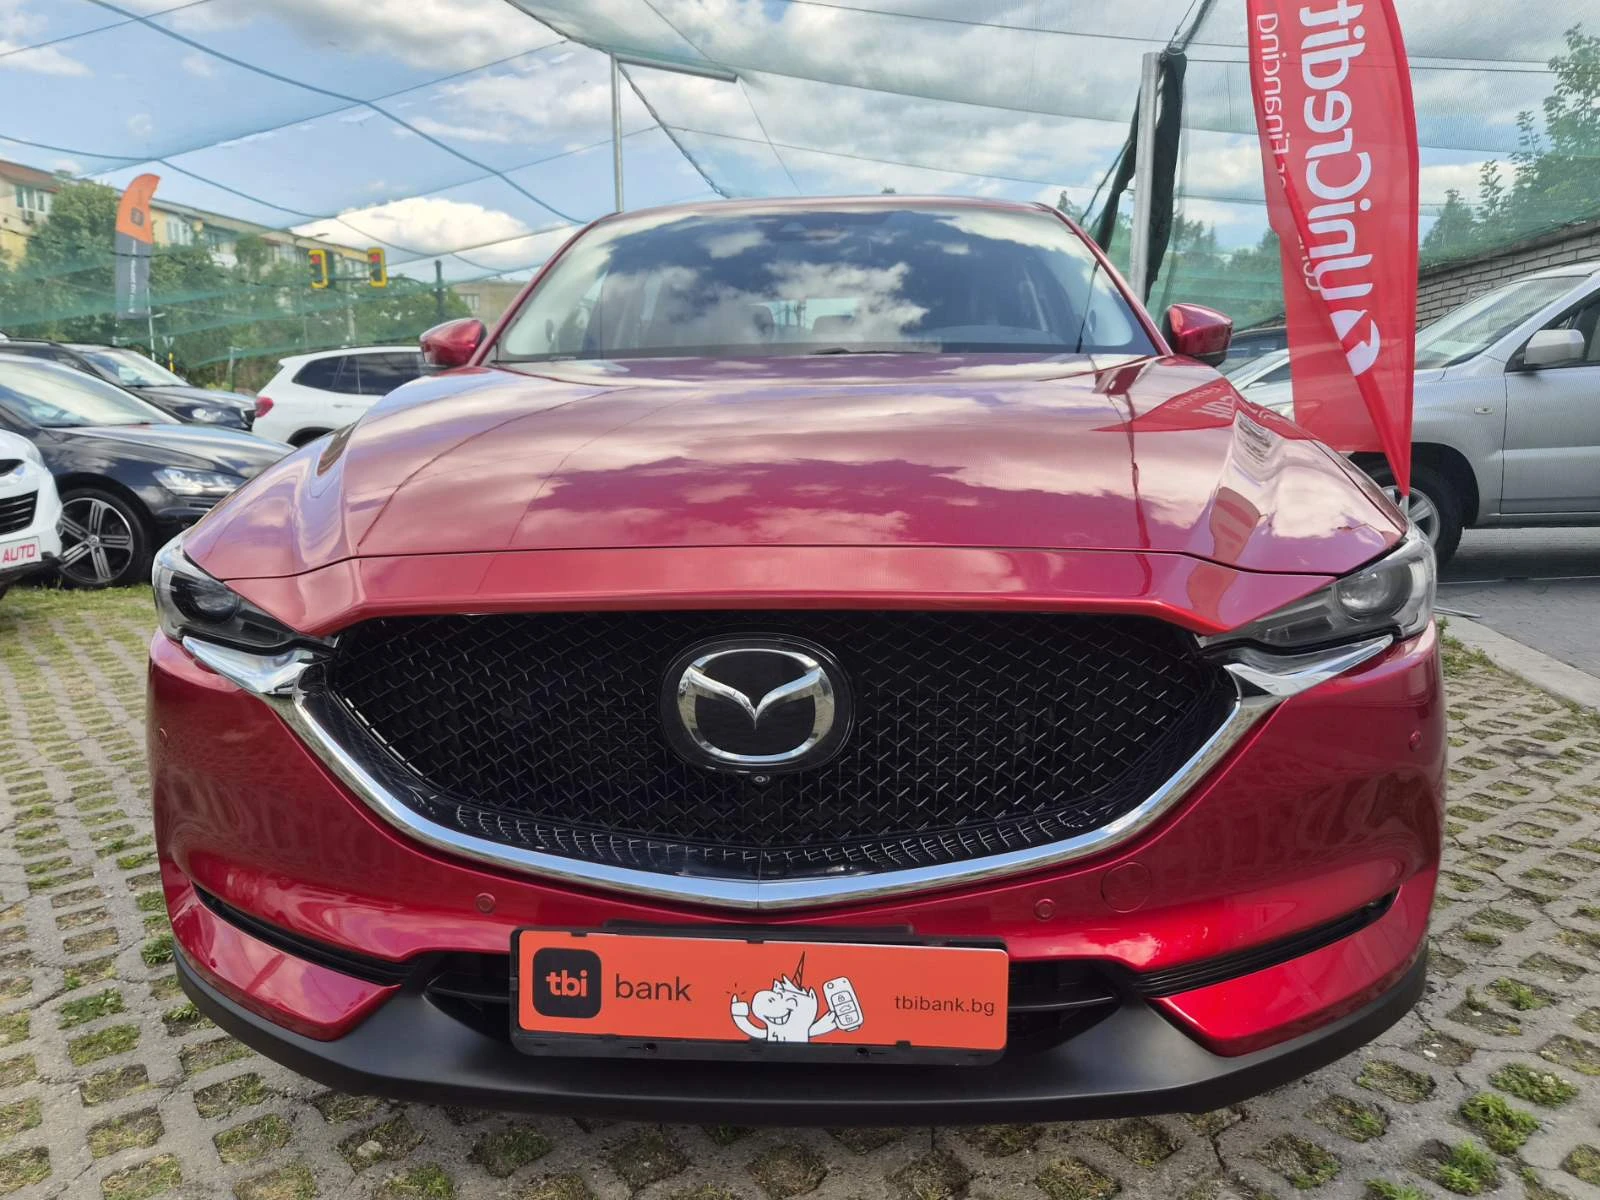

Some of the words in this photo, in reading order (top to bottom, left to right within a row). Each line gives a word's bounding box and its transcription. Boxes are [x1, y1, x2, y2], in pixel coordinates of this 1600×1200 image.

[3, 543, 36, 563] AUTO
[545, 969, 588, 998] tbi
[615, 973, 693, 1002] bank
[894, 995, 995, 1017] tbibank.bg
